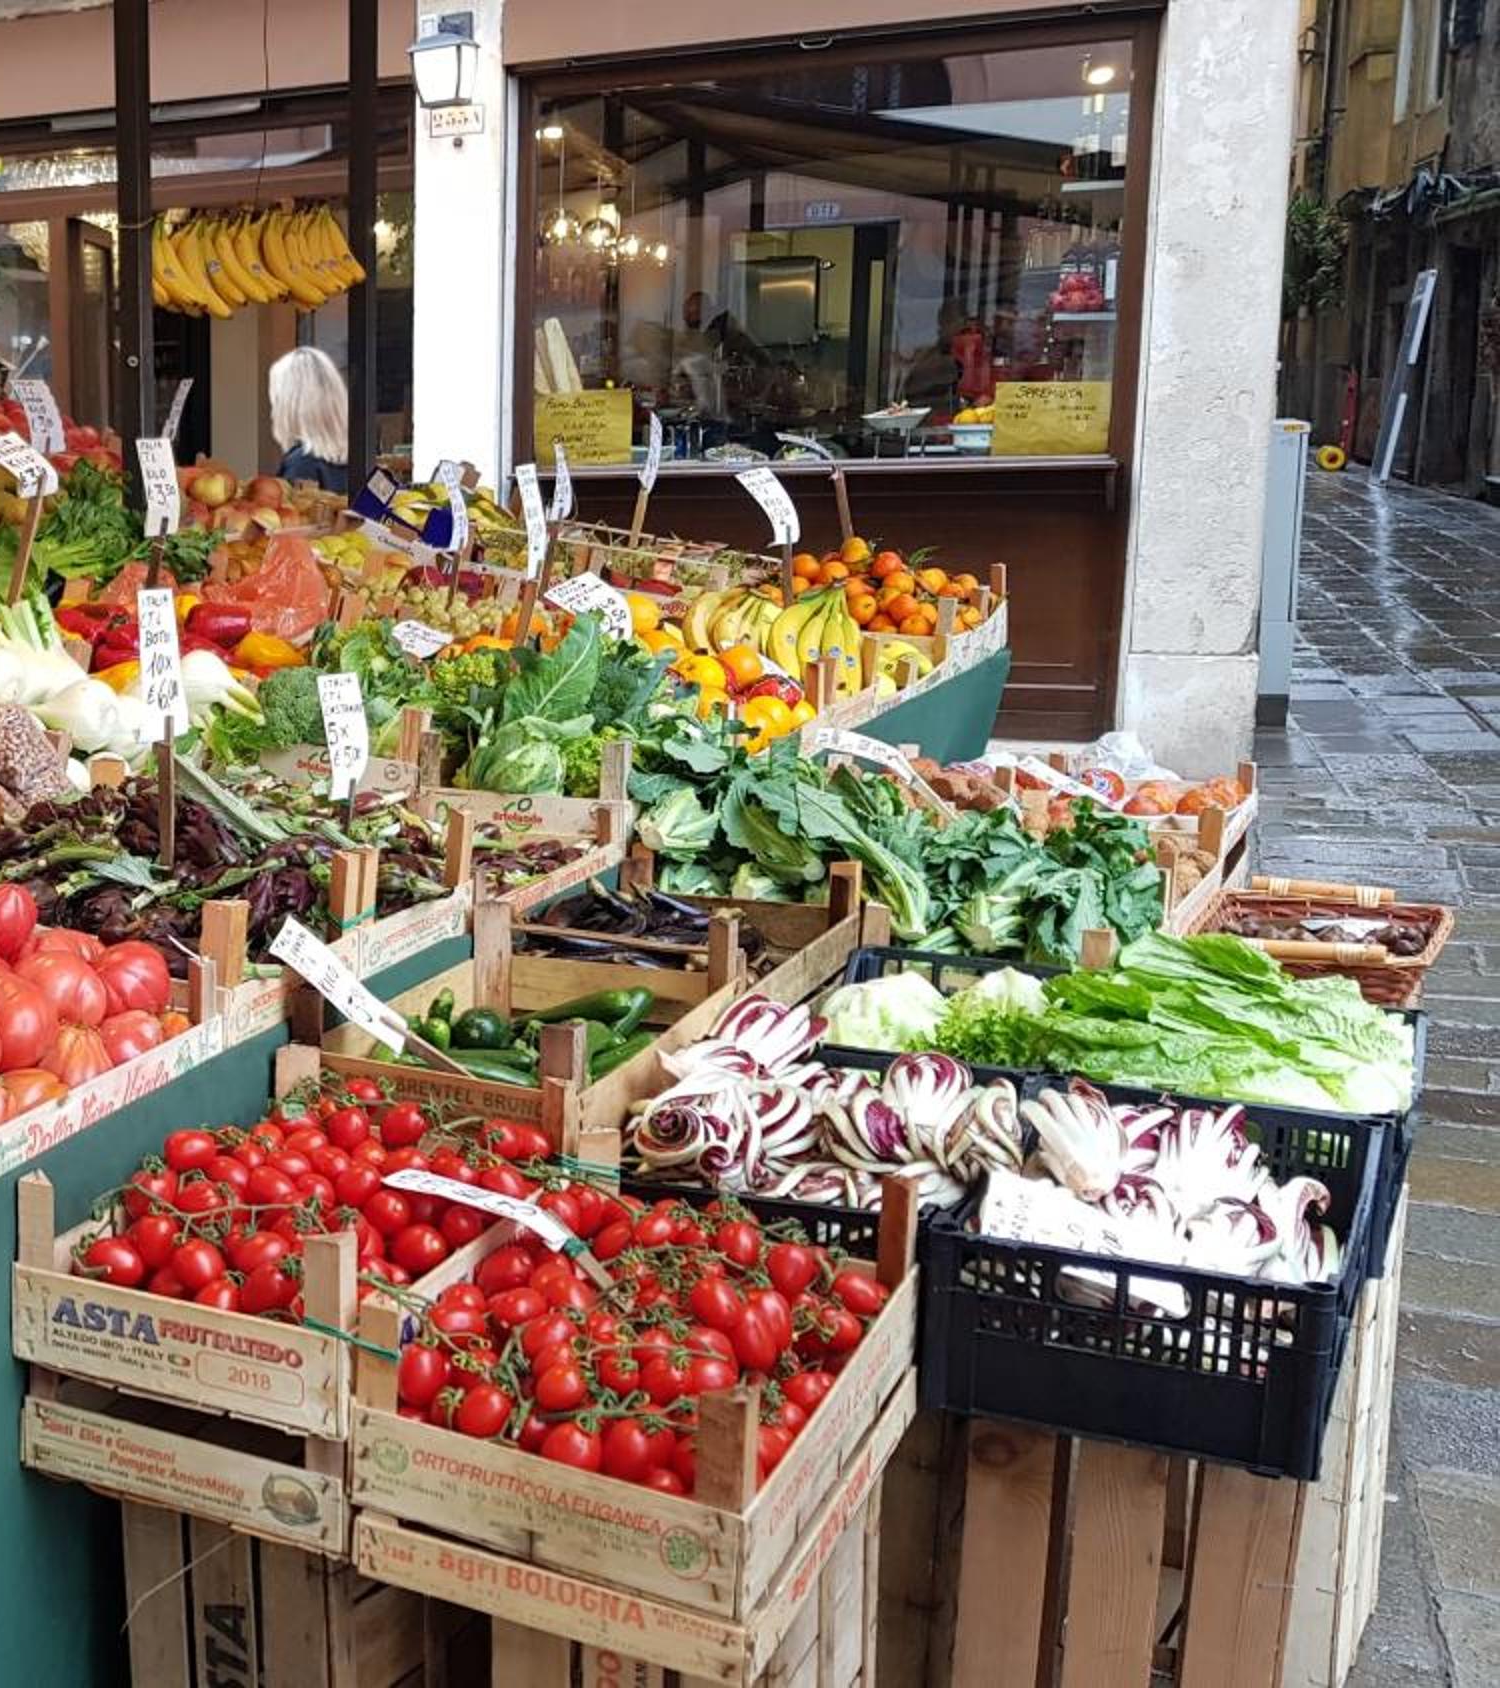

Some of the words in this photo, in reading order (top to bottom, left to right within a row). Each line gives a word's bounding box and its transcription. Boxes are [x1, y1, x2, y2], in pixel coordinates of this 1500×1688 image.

[142, 594, 168, 607] ITALIA
[323, 677, 351, 689] ITALIA
[51, 1295, 161, 1346] ASTA
[227, 1365, 272, 1392] 2018
[411, 1450, 571, 1508] ORTOFRUTTICOLA
[571, 1496, 664, 1536] EUGANEA
[439, 1550, 499, 1587] agri
[503, 1565, 647, 1631] BOLOGNA
